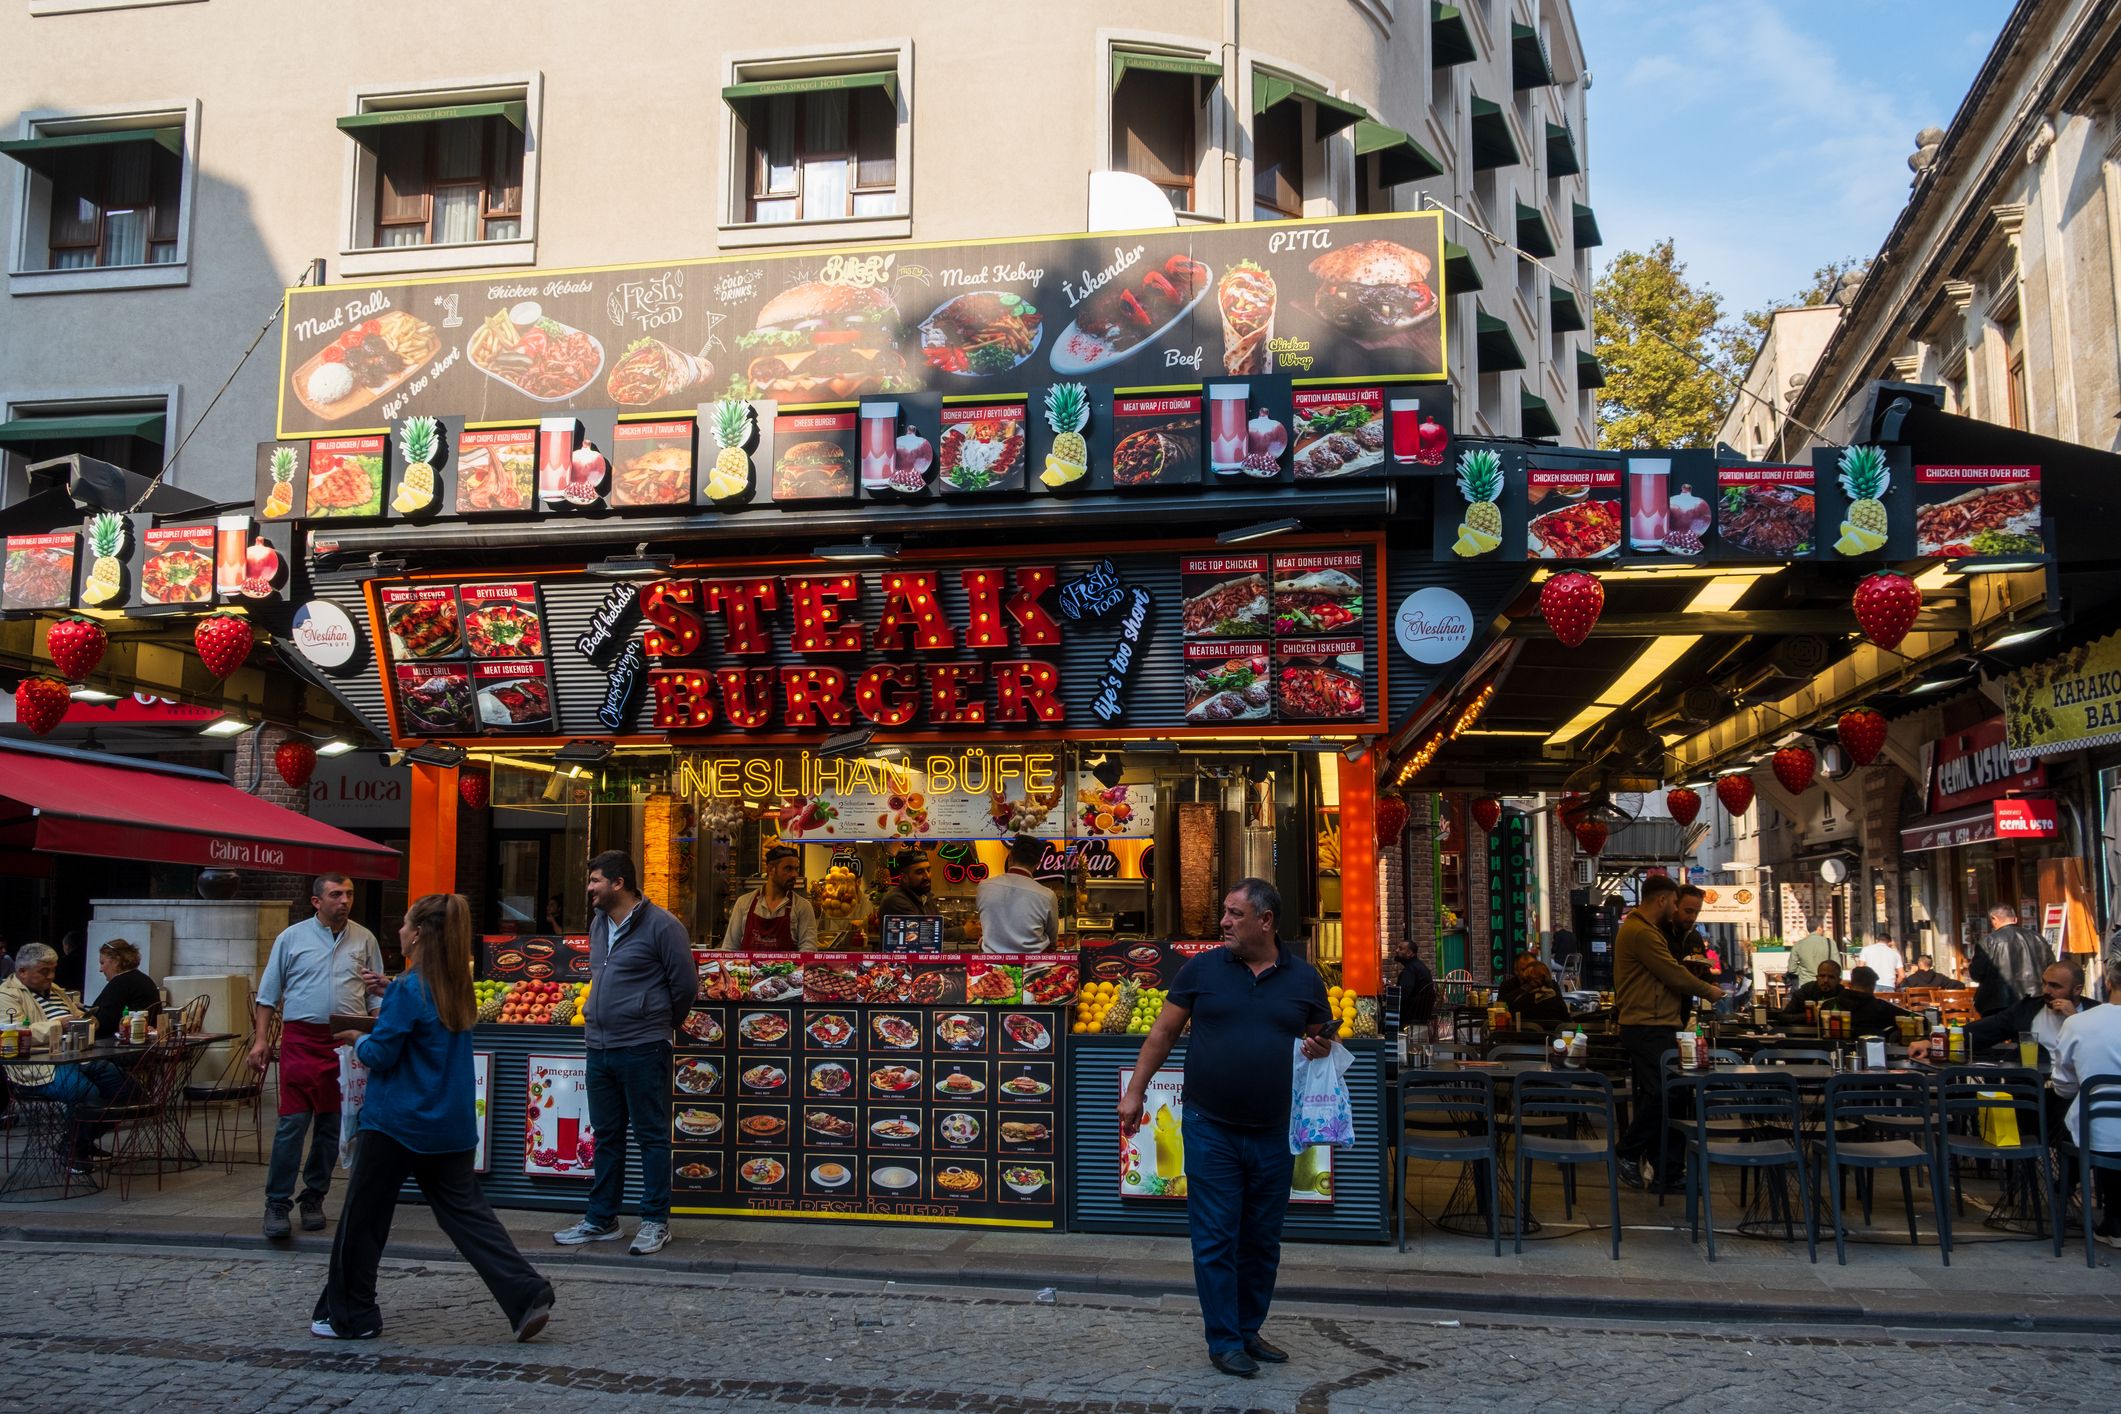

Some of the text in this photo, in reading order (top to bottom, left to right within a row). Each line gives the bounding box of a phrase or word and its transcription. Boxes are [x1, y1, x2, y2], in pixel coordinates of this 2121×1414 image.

[1269, 229, 1332, 254] PITA
[721, 275, 744, 290] COLD
[940, 261, 1045, 289] Meat Kebap
[1061, 244, 1145, 308] İskender
[487, 280, 593, 300] Chicken Kebabs
[721, 284, 752, 302] DRINKS
[294, 289, 391, 342] Meat Balls
[637, 305, 683, 332] FOOD
[1268, 336, 1310, 352] Chicken
[1164, 346, 1203, 371] Beef
[1278, 352, 1314, 371] Wrap
[408, 378, 429, 400] too
[430, 346, 460, 380] short
[1296, 393, 1321, 403] PORTION
[1322, 392, 1356, 402] MEATBALLS
[1360, 390, 1379, 401] KÖFTE
[1123, 402, 1140, 411] MEAT
[1140, 402, 1157, 411] WRAP
[1161, 401, 1168, 410] ET
[794, 417, 836, 427] CHEESE BURGER
[943, 410, 962, 420] DONER
[461, 434, 477, 444] LAMP
[477, 433, 494, 443] CHOPS
[619, 426, 641, 436] CHICKEN
[641, 426, 653, 435] PITA
[657, 425, 674, 434] TAVUK
[316, 441, 336, 450] GRILLED
[337, 440, 356, 449] CHICKEN
[1533, 473, 1560, 483] CHICKEN
[1560, 473, 1590, 483] ISKENDER
[1595, 472, 1615, 482] TAVUK
[1719, 471, 1745, 481] PORTION
[1745, 471, 1761, 480] MEAT
[1761, 470, 1781, 480] DONER
[1786, 470, 1793, 480] ET
[1794, 468, 1815, 480] DÖNER
[1925, 468, 2030, 478] CHICKEN DONER OVER RICE
[7, 538, 26, 547] PORTION
[1189, 559, 1258, 571] RICE TOP CHICKEN
[1276, 555, 1362, 568] MEAT DONER OVER RICE
[391, 591, 446, 601] CHICKEN SKEWER
[496, 588, 518, 597] KEBAB
[598, 586, 636, 627] kebabs
[1089, 588, 1125, 617] FOOD
[640, 566, 1062, 657] STEAK
[304, 625, 347, 641] Neslihan
[1411, 615, 1467, 635] Neslihan
[1093, 588, 1150, 721] life's too short
[1189, 645, 1262, 656] MEATBALL PORTION
[1283, 642, 1356, 653] CHICKEN ISKENDER
[434, 667, 451, 675] GRILL
[483, 665, 534, 675] MEAT ISKENDER
[647, 660, 1065, 729] BURGER
[926, 748, 1055, 795] BÜFE
[340, 775, 401, 801] Loca
[210, 840, 284, 865] Cabra Loca
[1490, 836, 1504, 984] PHARMACY
[575, 1081, 587, 1092] Ju
[748, 1198, 795, 1217] THE
